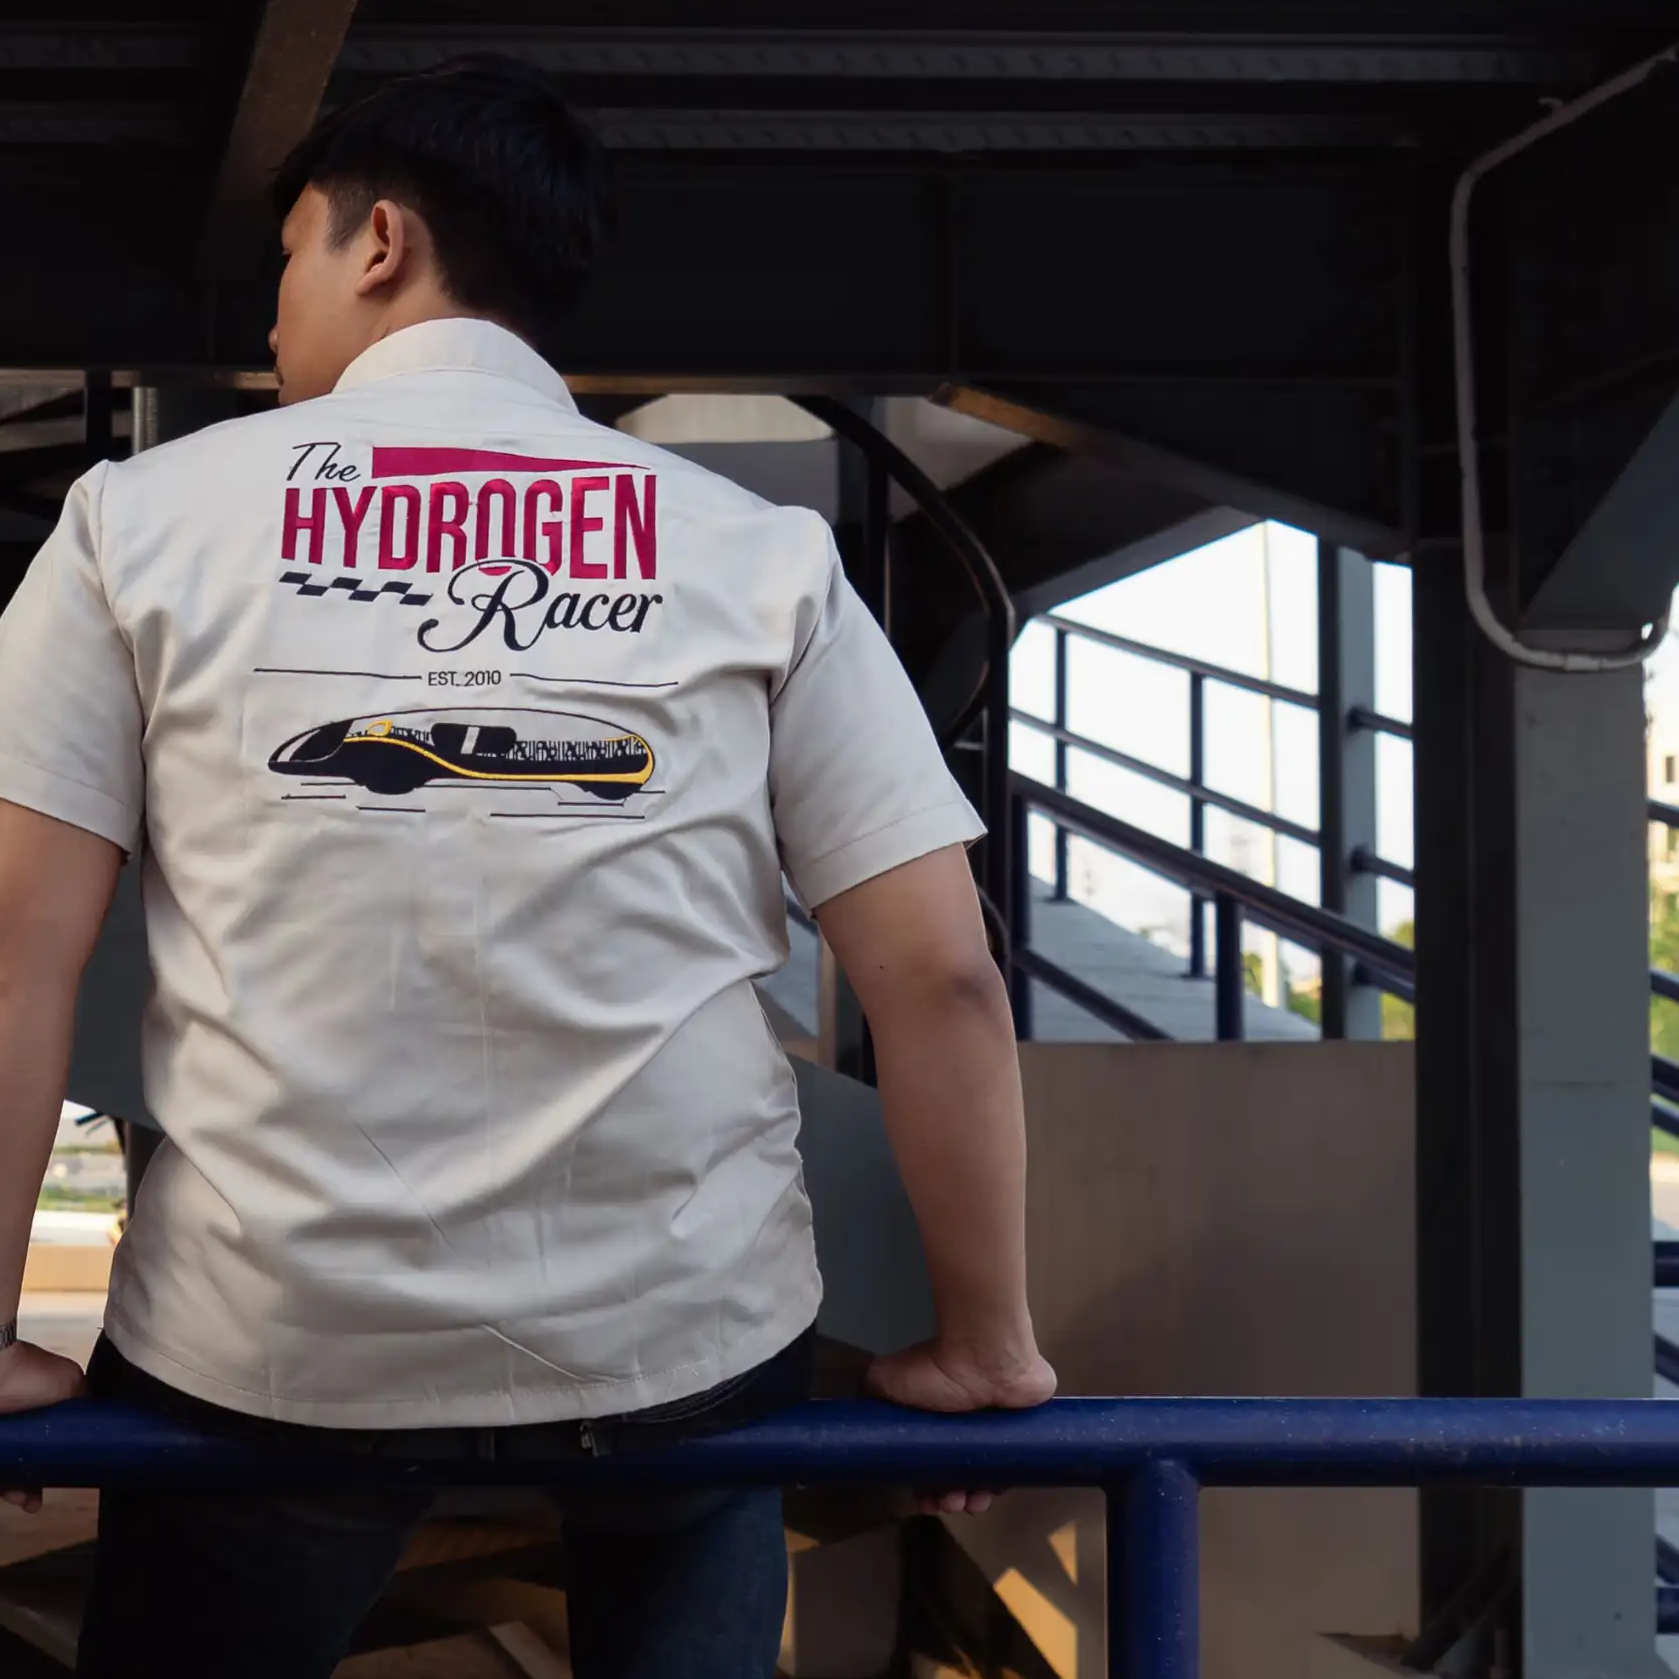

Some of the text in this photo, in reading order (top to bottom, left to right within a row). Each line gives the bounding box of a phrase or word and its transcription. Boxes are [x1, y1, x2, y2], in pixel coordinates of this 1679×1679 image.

[286, 442, 360, 483] The
[280, 474, 657, 580] HYDROGEN
[417, 558, 663, 652] Racer
[427, 669, 502, 687] EST. 2010
